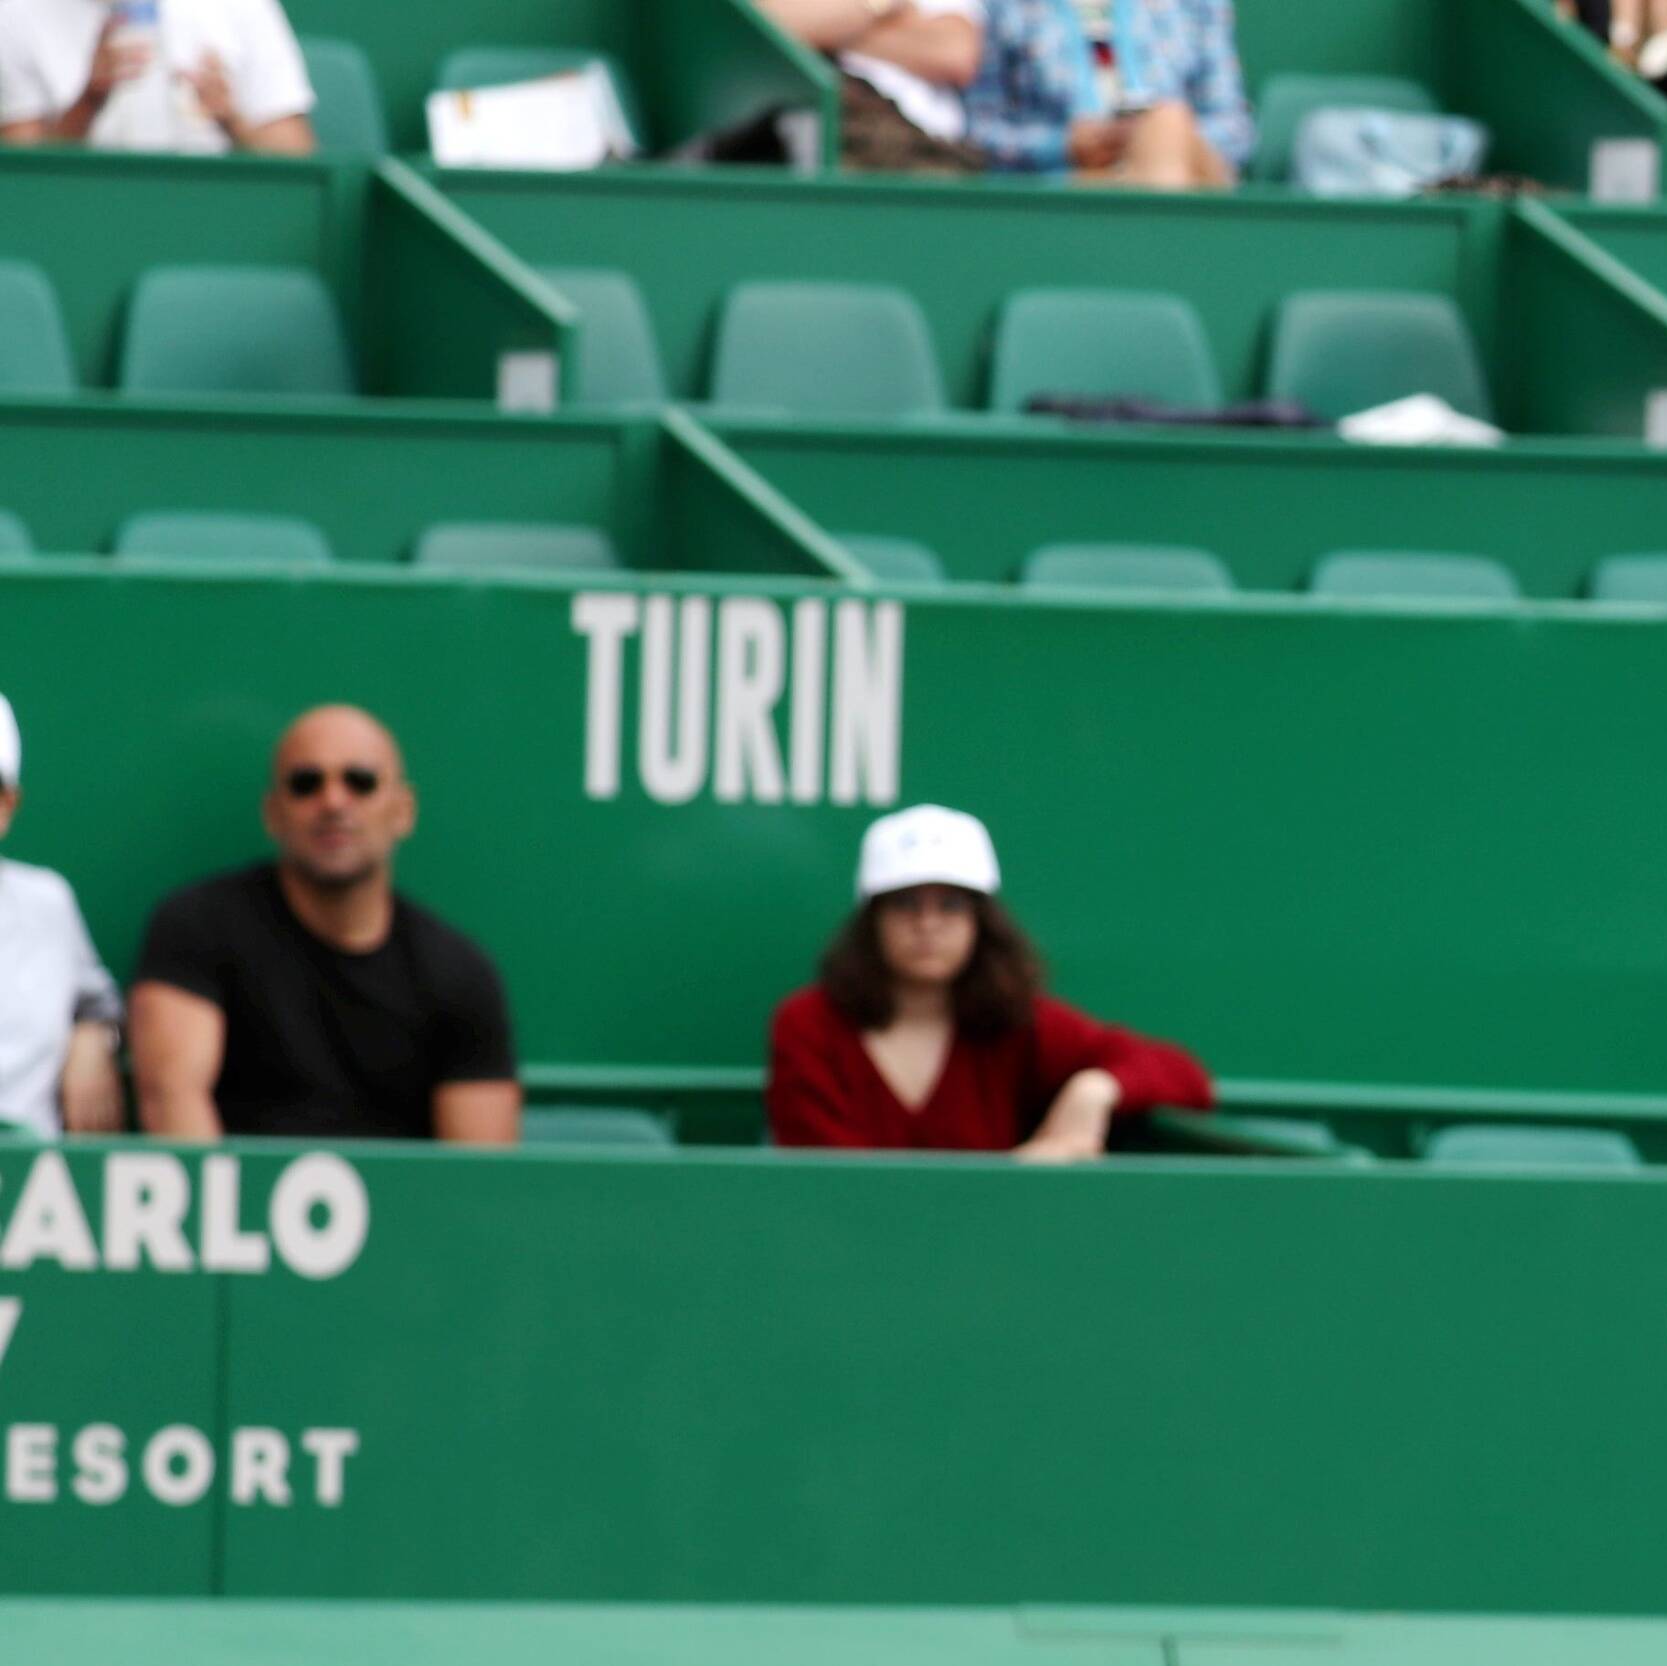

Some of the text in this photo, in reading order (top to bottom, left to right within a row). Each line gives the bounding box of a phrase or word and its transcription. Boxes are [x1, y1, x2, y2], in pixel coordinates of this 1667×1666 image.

[571, 591, 905, 806] TURIN
[0, 1149, 370, 1280] ARLO
[5, 1423, 360, 1507] ESORT
